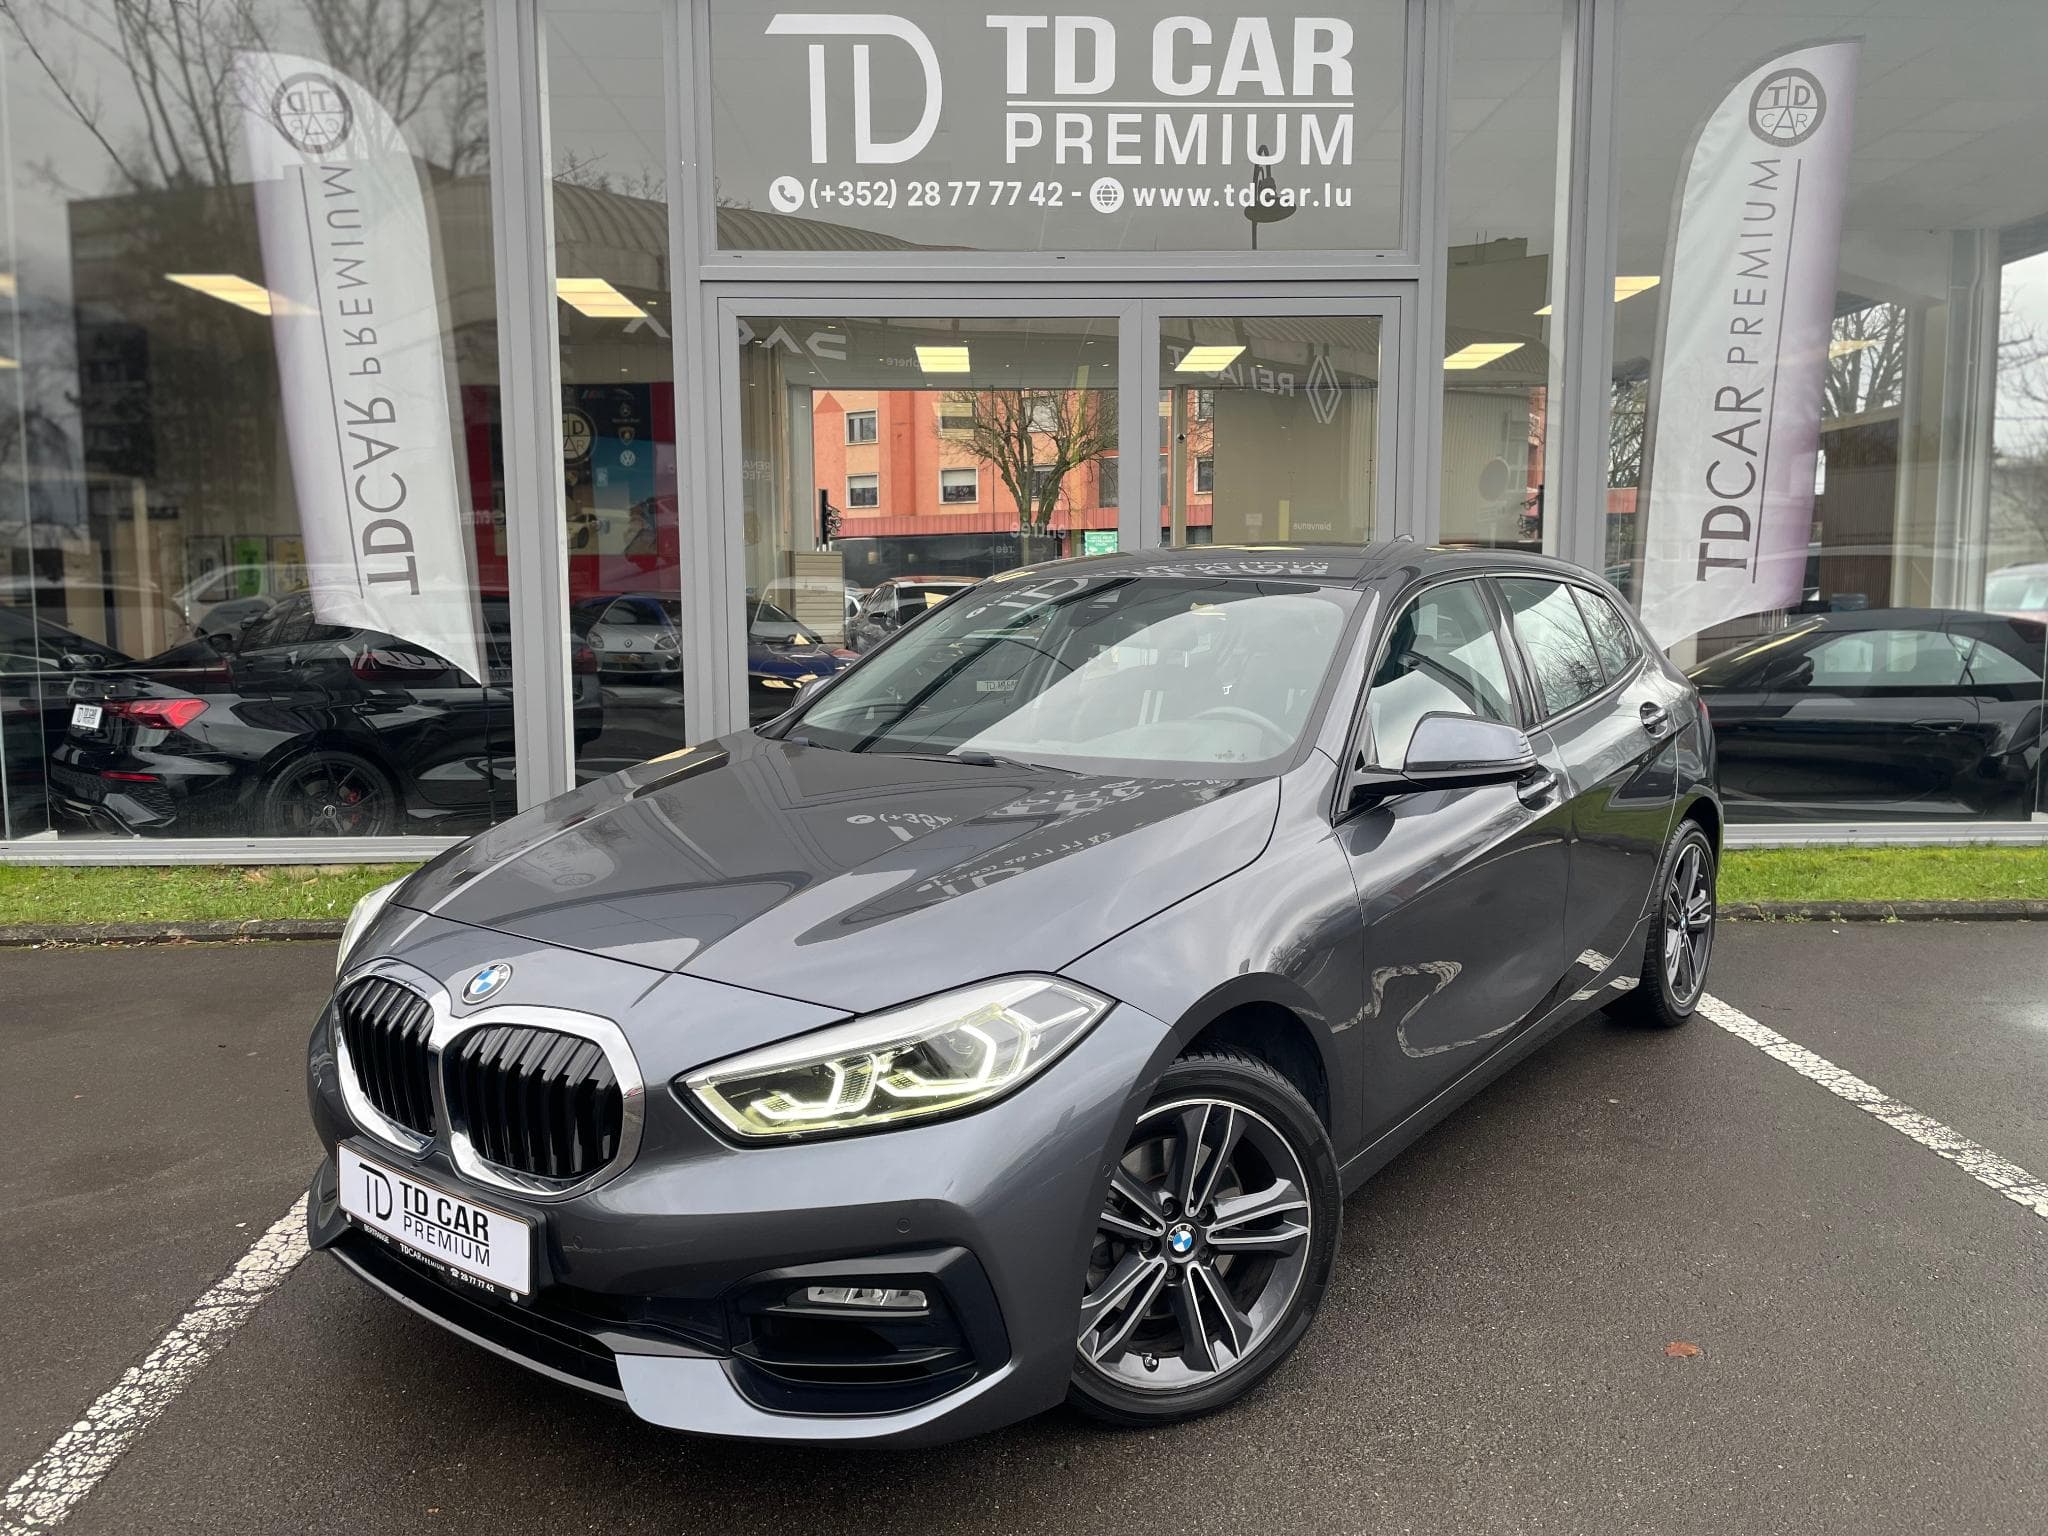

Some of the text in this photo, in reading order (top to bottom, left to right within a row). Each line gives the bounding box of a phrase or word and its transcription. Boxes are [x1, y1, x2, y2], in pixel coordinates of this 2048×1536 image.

[986, 14, 1354, 96] TD CAR
[1006, 112, 1354, 166] PREMIUM
[809, 178, 897, 209] (+352)
[907, 181, 941, 207] 28
[947, 181, 981, 206] 77
[988, 181, 1022, 206] 77
[1028, 181, 1063, 207] 42
[1132, 182, 1352, 208] www.tdcar.lu
[1696, 158, 1781, 582] TDCAR PREMIUM
[399, 1179, 489, 1242] TD CAR
[403, 1214, 490, 1268] PREMIUM
